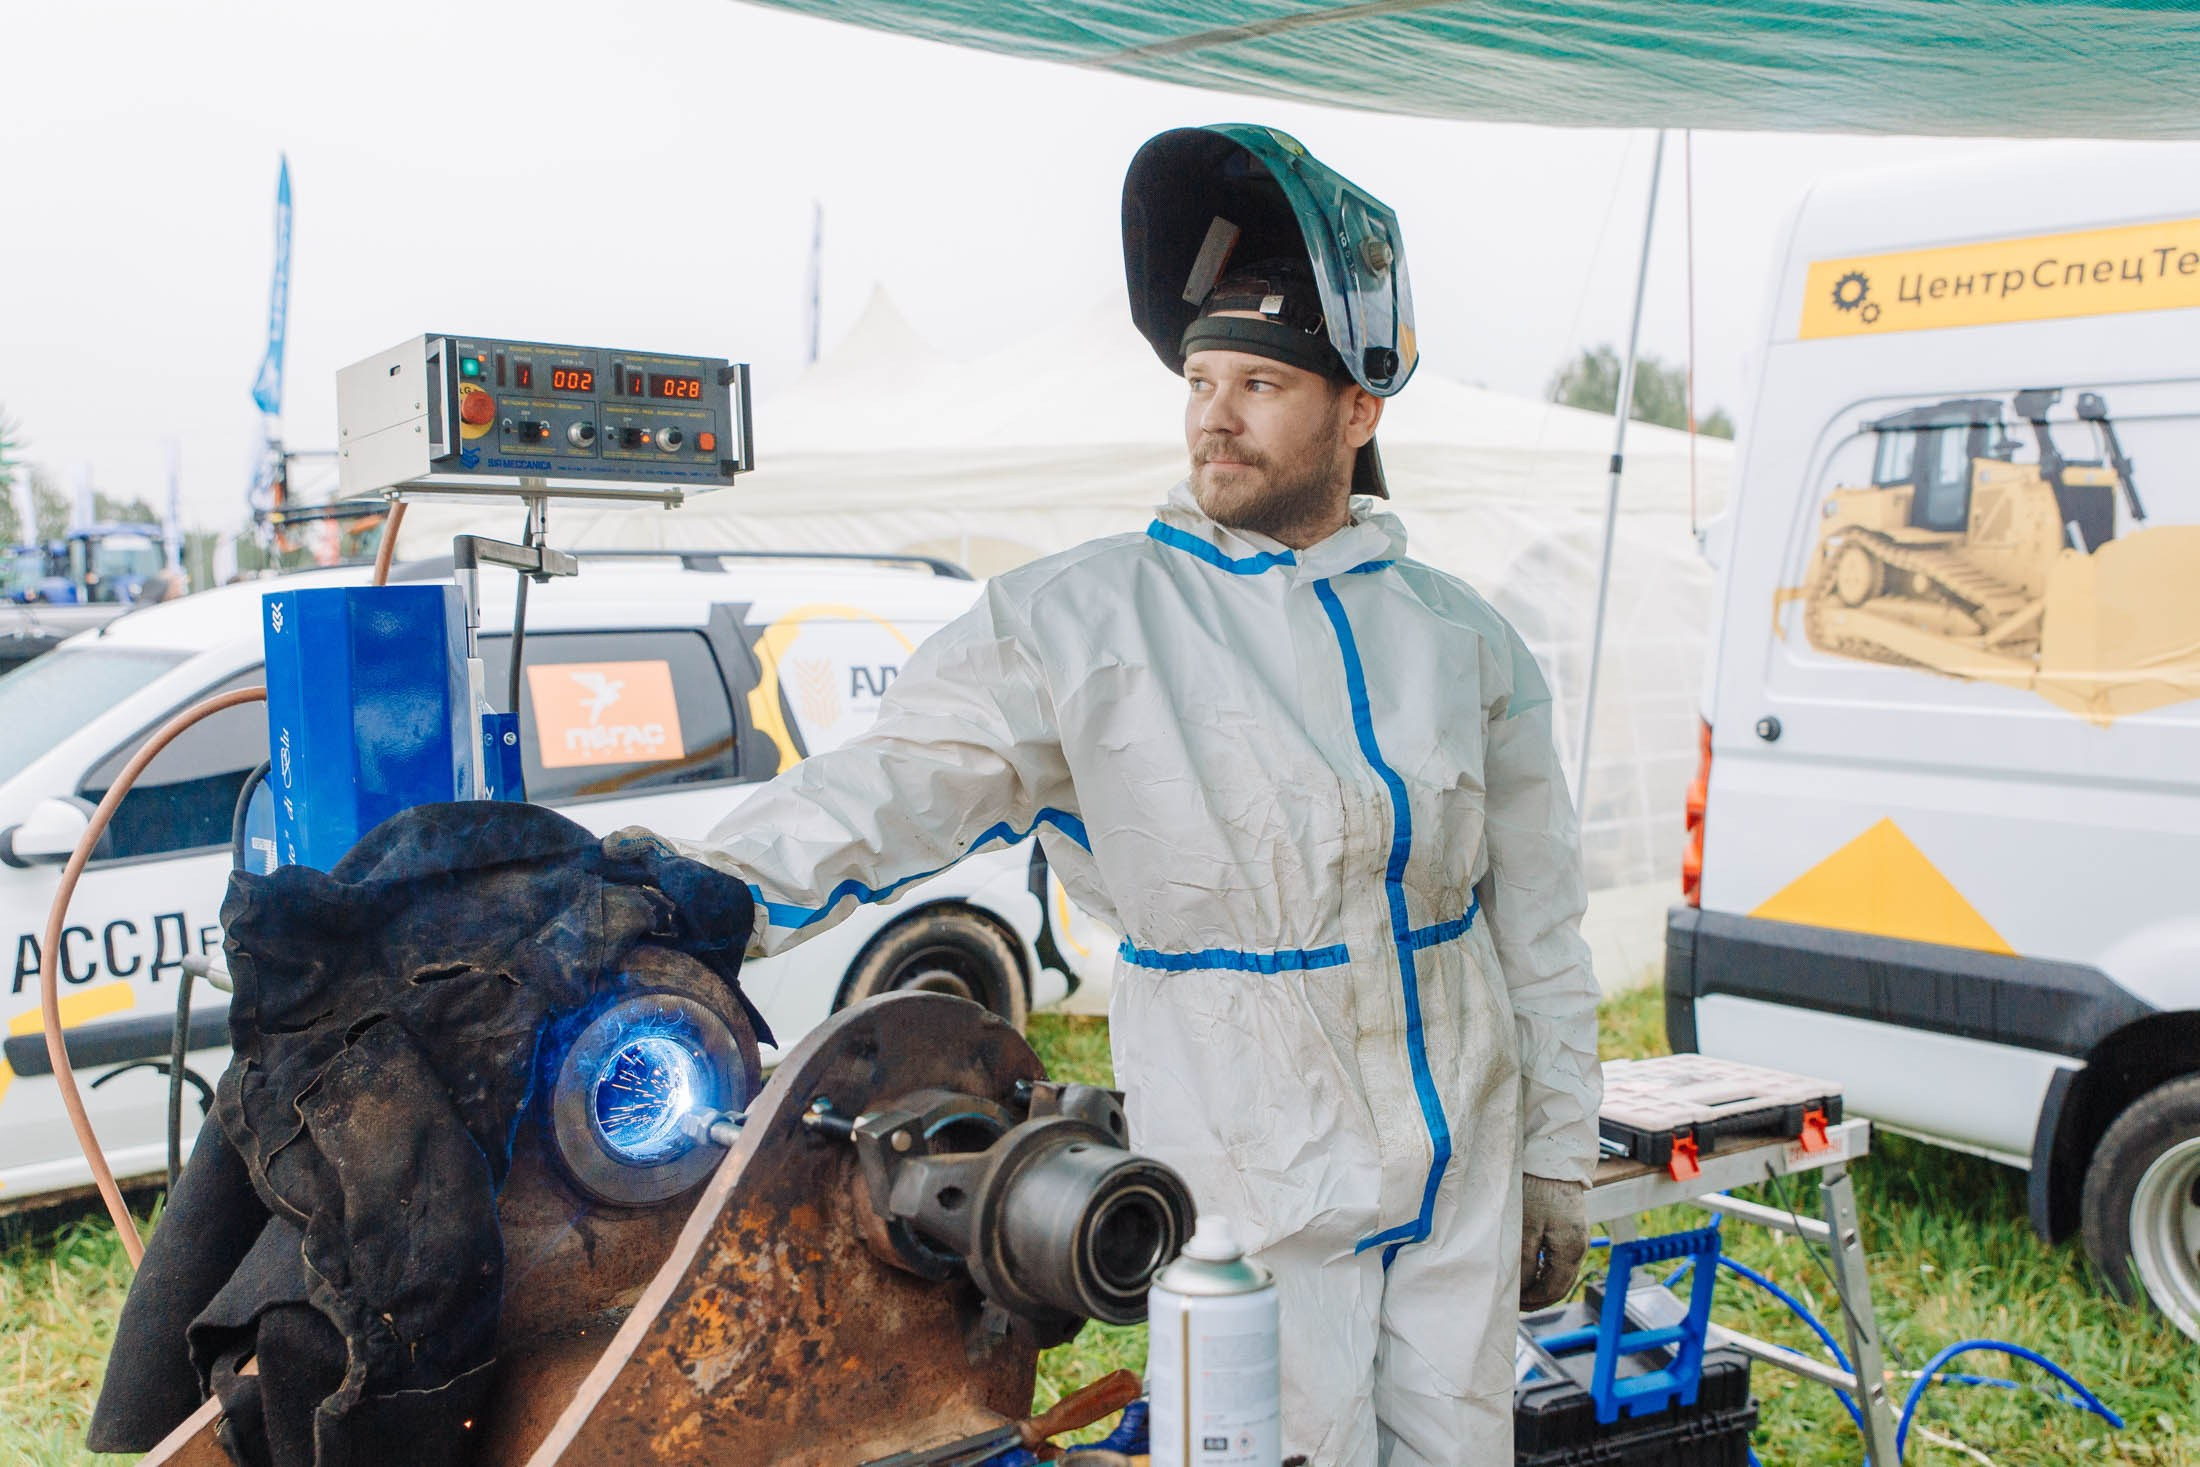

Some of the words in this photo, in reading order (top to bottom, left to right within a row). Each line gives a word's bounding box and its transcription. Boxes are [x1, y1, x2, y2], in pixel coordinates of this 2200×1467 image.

[1897, 246, 2200, 305] ЦентрСпецТе
[522, 368, 529, 385] 1
[553, 370, 592, 390] 002
[634, 377, 641, 393] 1
[663, 379, 701, 399] 028
